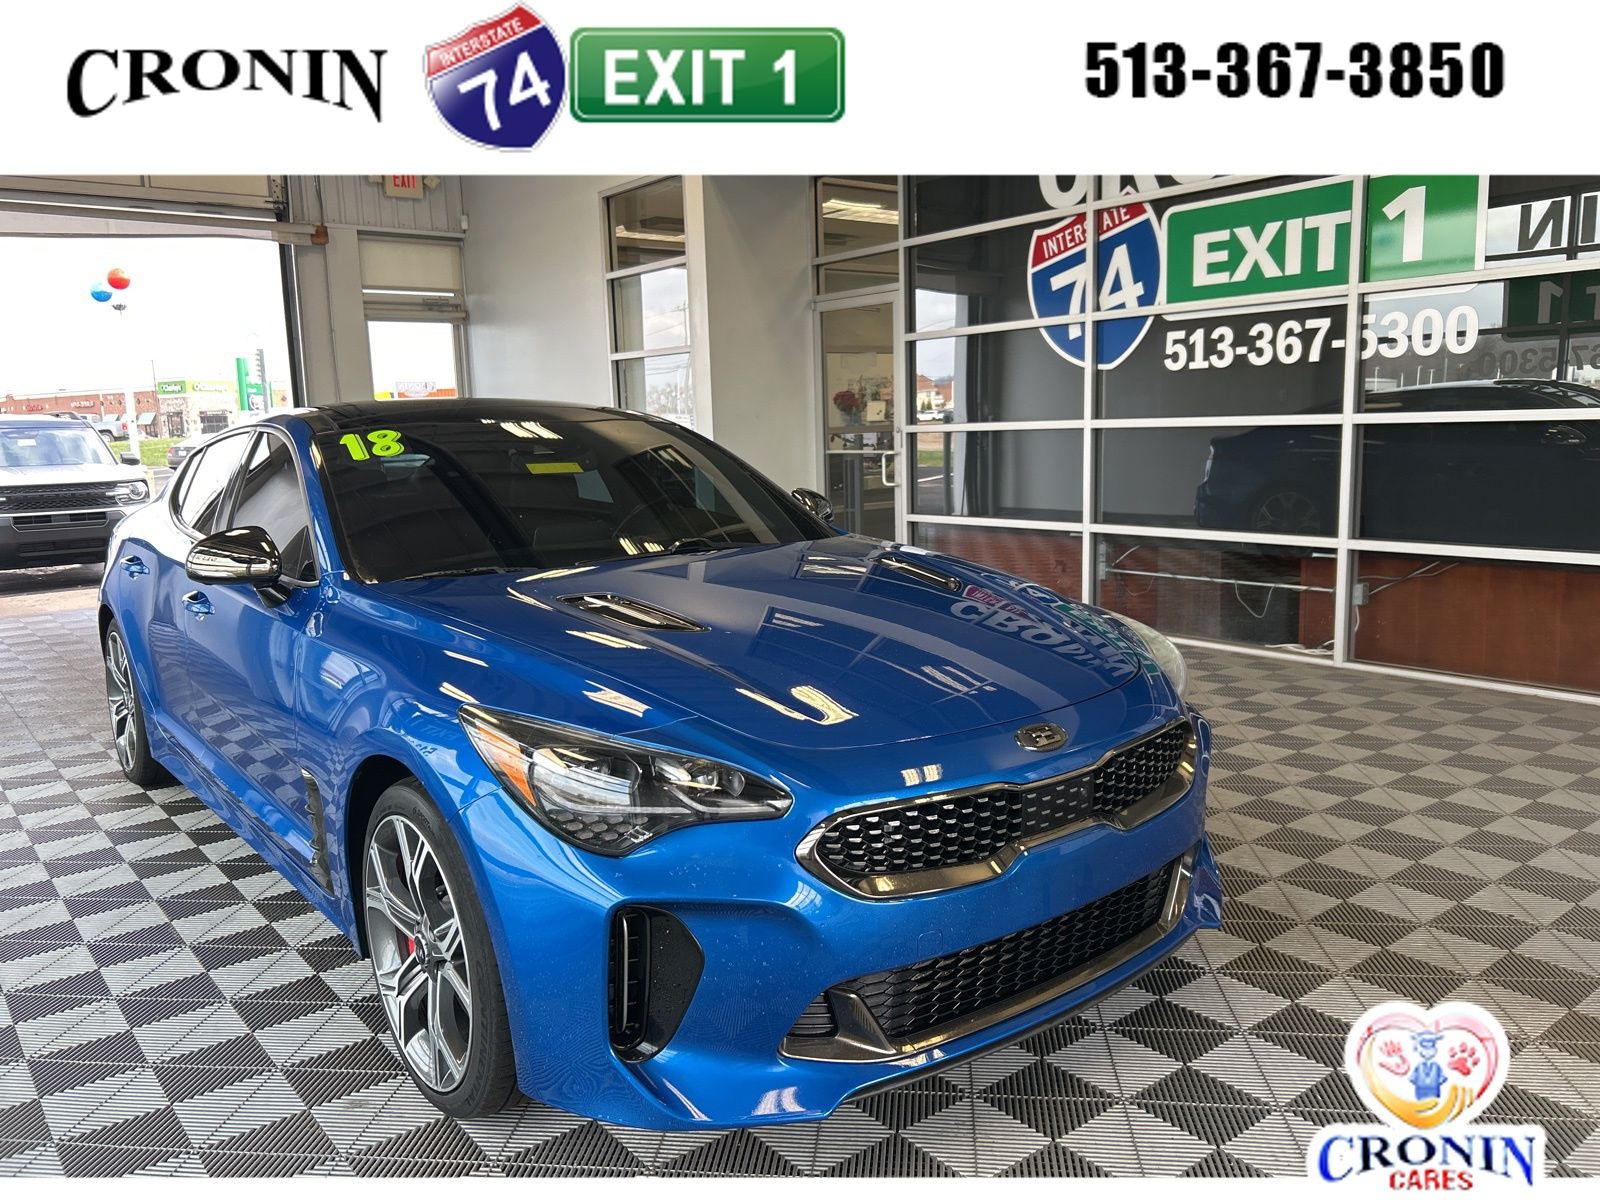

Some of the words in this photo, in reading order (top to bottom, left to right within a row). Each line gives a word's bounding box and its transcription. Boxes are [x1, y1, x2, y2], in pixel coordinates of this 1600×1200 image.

[1042, 206, 1131, 259] INTERATE
[1192, 210, 1352, 288] EXIT
[1381, 185, 1428, 263] 1
[1049, 243, 1145, 341] 74
[1163, 305, 1480, 372] 513-367-5300
[339, 429, 405, 461] 18
